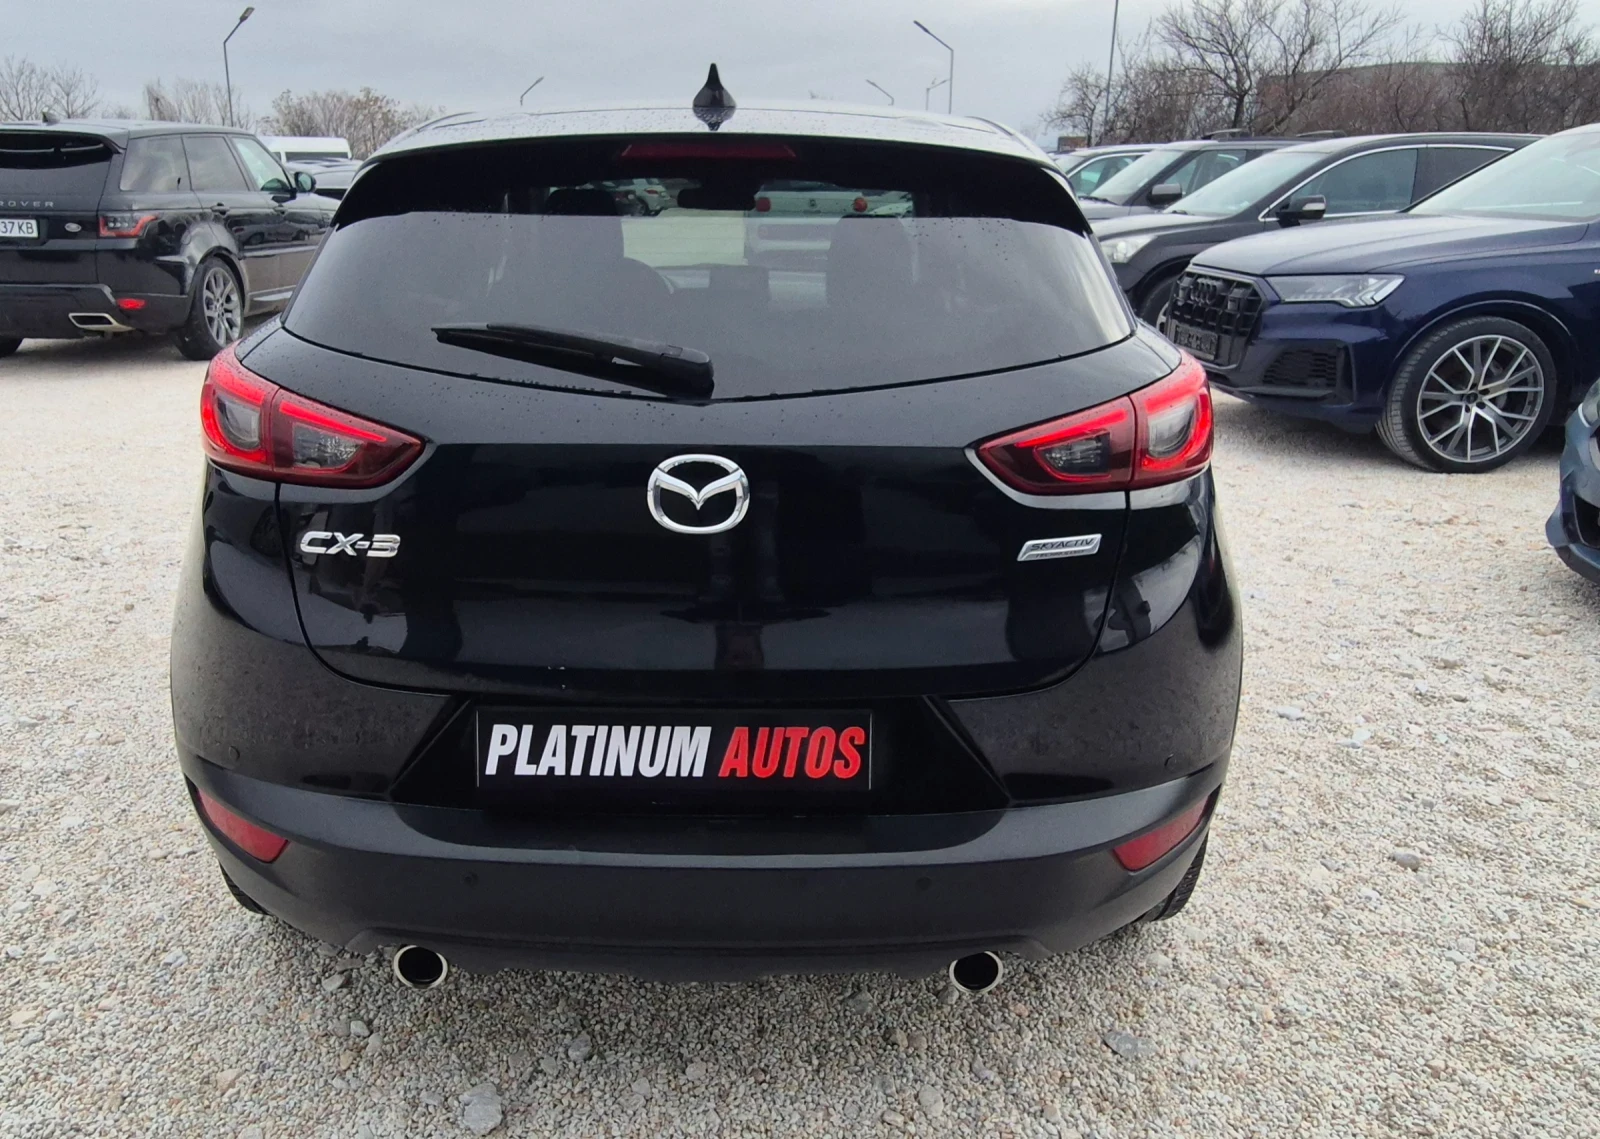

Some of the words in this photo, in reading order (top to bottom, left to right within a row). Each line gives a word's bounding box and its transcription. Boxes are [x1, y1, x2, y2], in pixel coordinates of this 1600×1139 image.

[300, 530, 401, 558] CX-3
[1031, 538, 1094, 551] SKYACTIV
[485, 724, 711, 777] PLATINUM
[718, 726, 865, 779] AUTOS
